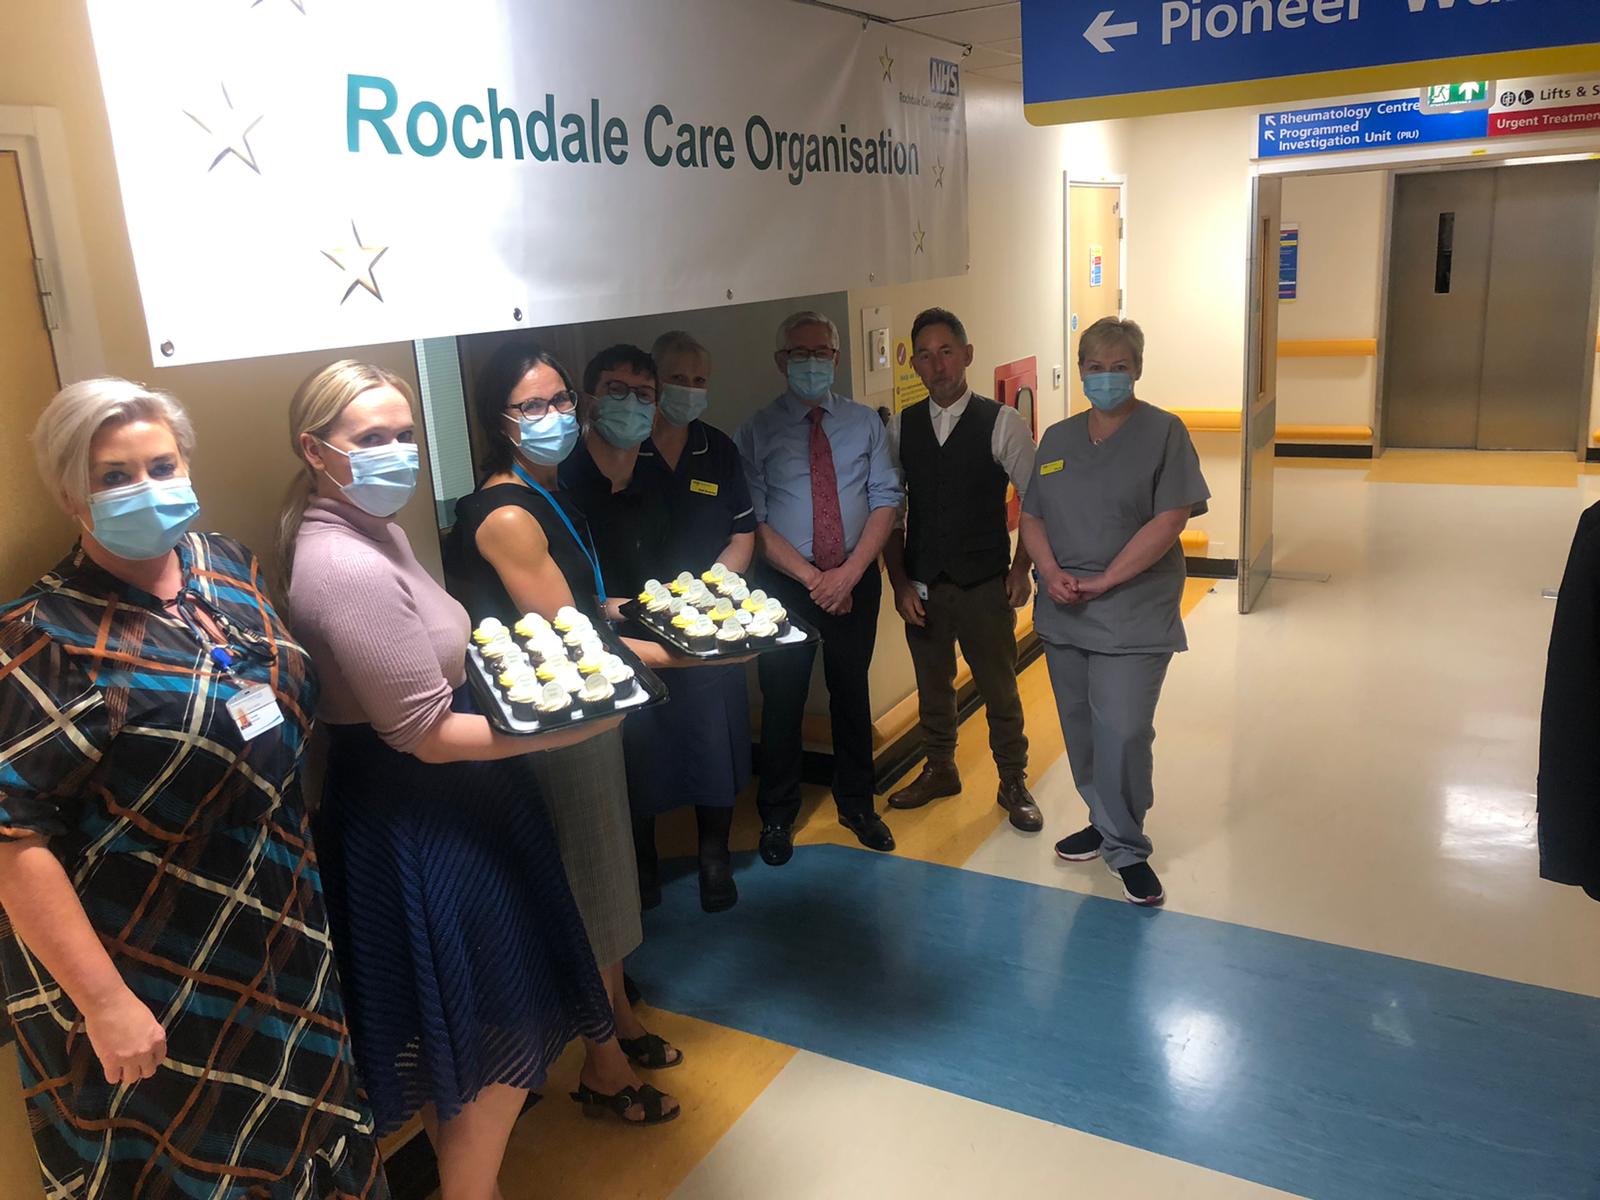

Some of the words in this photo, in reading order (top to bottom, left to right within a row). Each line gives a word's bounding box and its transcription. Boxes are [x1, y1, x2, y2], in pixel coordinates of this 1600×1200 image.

[1162, 0, 1360, 45] Pioneer
[931, 61, 958, 94] NHS
[1540, 87, 1571, 100] Lifts
[1576, 86, 1586, 97] &
[1280, 107, 1371, 125] Rheumatology
[1377, 100, 1419, 114] Centre
[1497, 116, 1538, 130] Urgent
[346, 73, 629, 165] Rochdale
[644, 104, 735, 169] Care
[745, 115, 919, 185] Organisation
[1279, 135, 1359, 151] Investigation
[1365, 129, 1391, 143] Unit
[1397, 129, 1419, 141] (PIU)
[1280, 121, 1359, 140] Programmed
